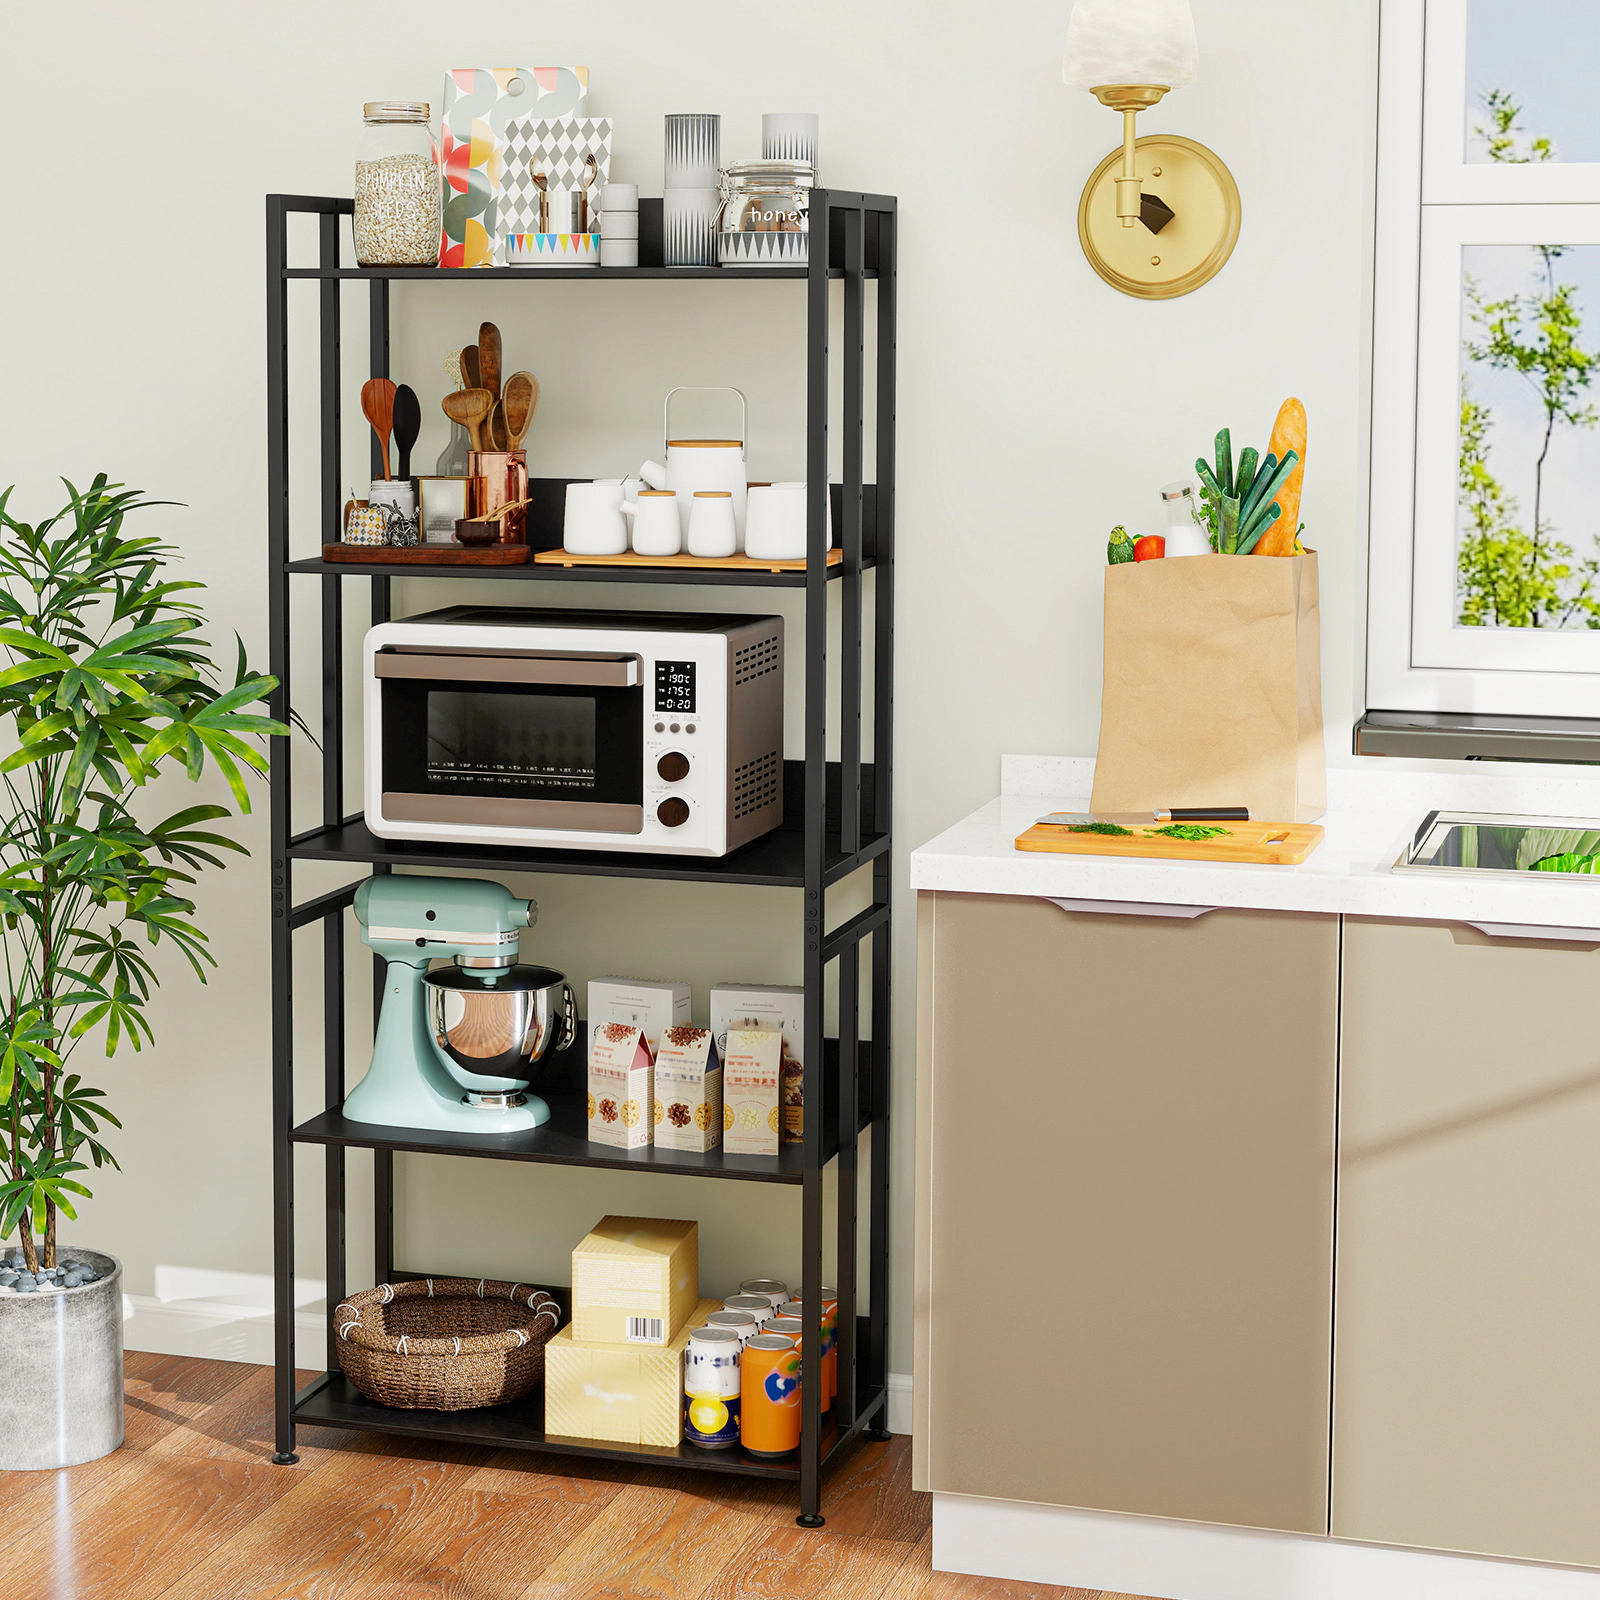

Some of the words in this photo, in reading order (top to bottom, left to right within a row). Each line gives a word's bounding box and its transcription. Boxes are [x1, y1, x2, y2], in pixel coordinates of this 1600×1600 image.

[365, 170, 425, 190] PUMPKIN
[370, 200, 416, 219] SEEDS
[751, 206, 809, 227] honey
[666, 698, 691, 709] 0:20
